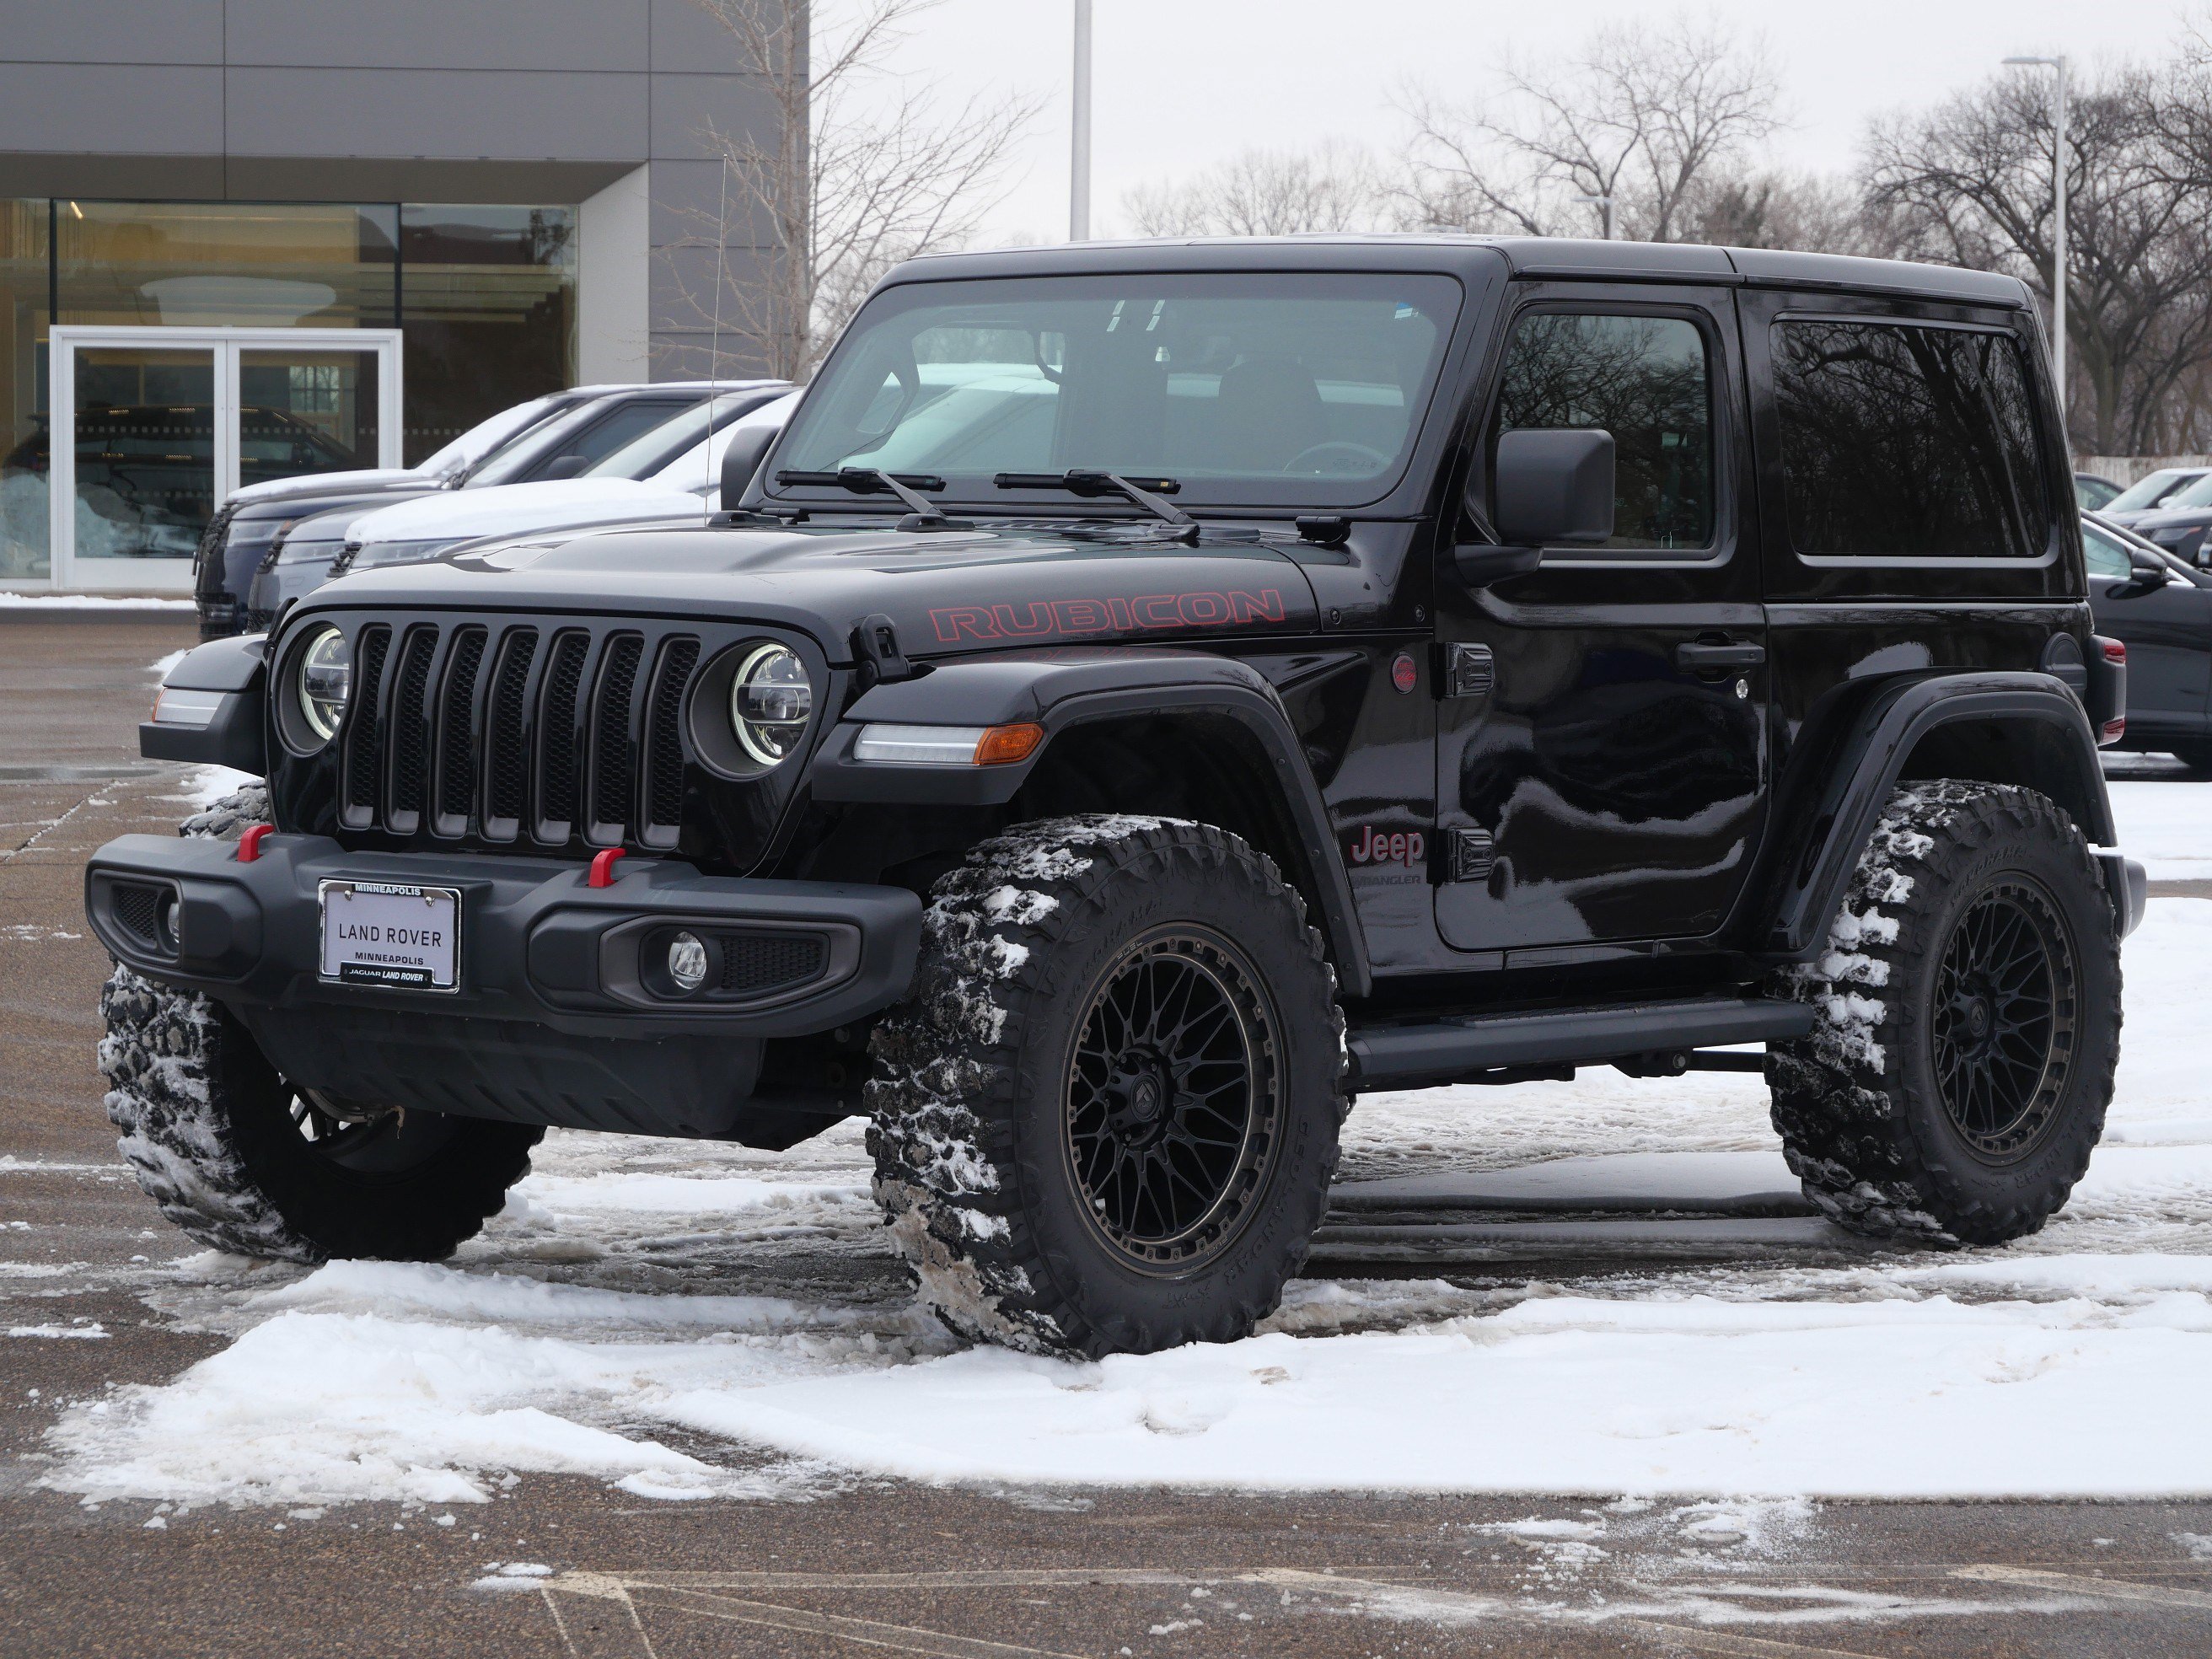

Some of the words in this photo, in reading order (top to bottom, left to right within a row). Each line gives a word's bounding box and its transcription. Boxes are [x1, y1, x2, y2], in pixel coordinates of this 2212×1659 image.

[929, 589, 1285, 641] RUBICON
[1351, 825, 1424, 867] Jeep
[1350, 874, 1420, 885] WRANGLER
[355, 883, 421, 896] MINNEAPOLIS
[339, 923, 379, 942] LAND
[387, 927, 442, 948] ROVER
[355, 952, 424, 965] MINNEAPOLIS
[382, 970, 400, 980] LAND
[400, 972, 423, 982] ROVER
